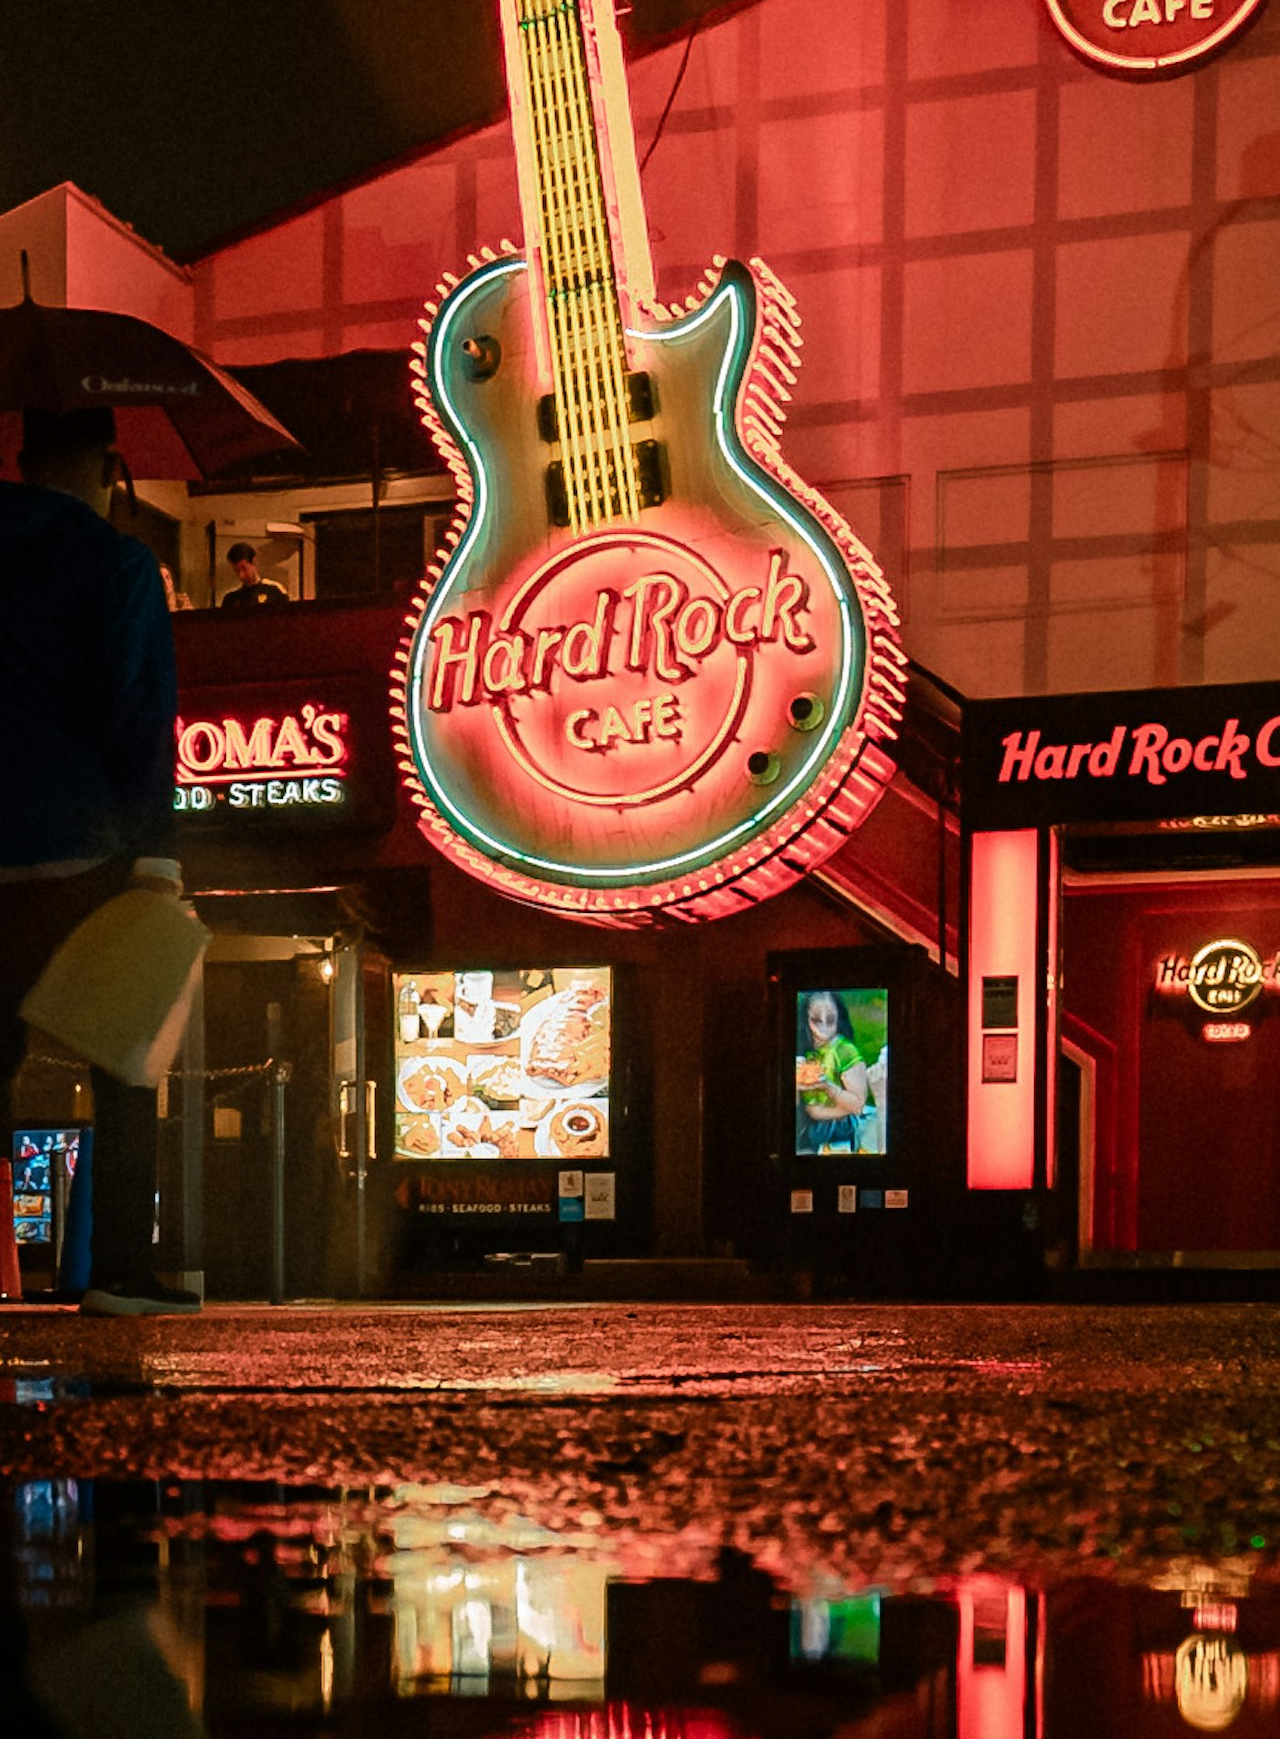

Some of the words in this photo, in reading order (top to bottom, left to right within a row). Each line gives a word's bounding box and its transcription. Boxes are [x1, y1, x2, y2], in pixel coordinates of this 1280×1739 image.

[430, 591, 617, 711] Hard
[623, 549, 815, 681] Rock
[175, 703, 347, 772] OMA'S
[565, 693, 684, 752] CAFE
[998, 725, 1127, 782] Hard
[1129, 718, 1250, 785] Rock
[228, 778, 344, 808] STEAKS
[1158, 955, 1227, 987] Hard
[508, 1203, 552, 1214] STEAKS
